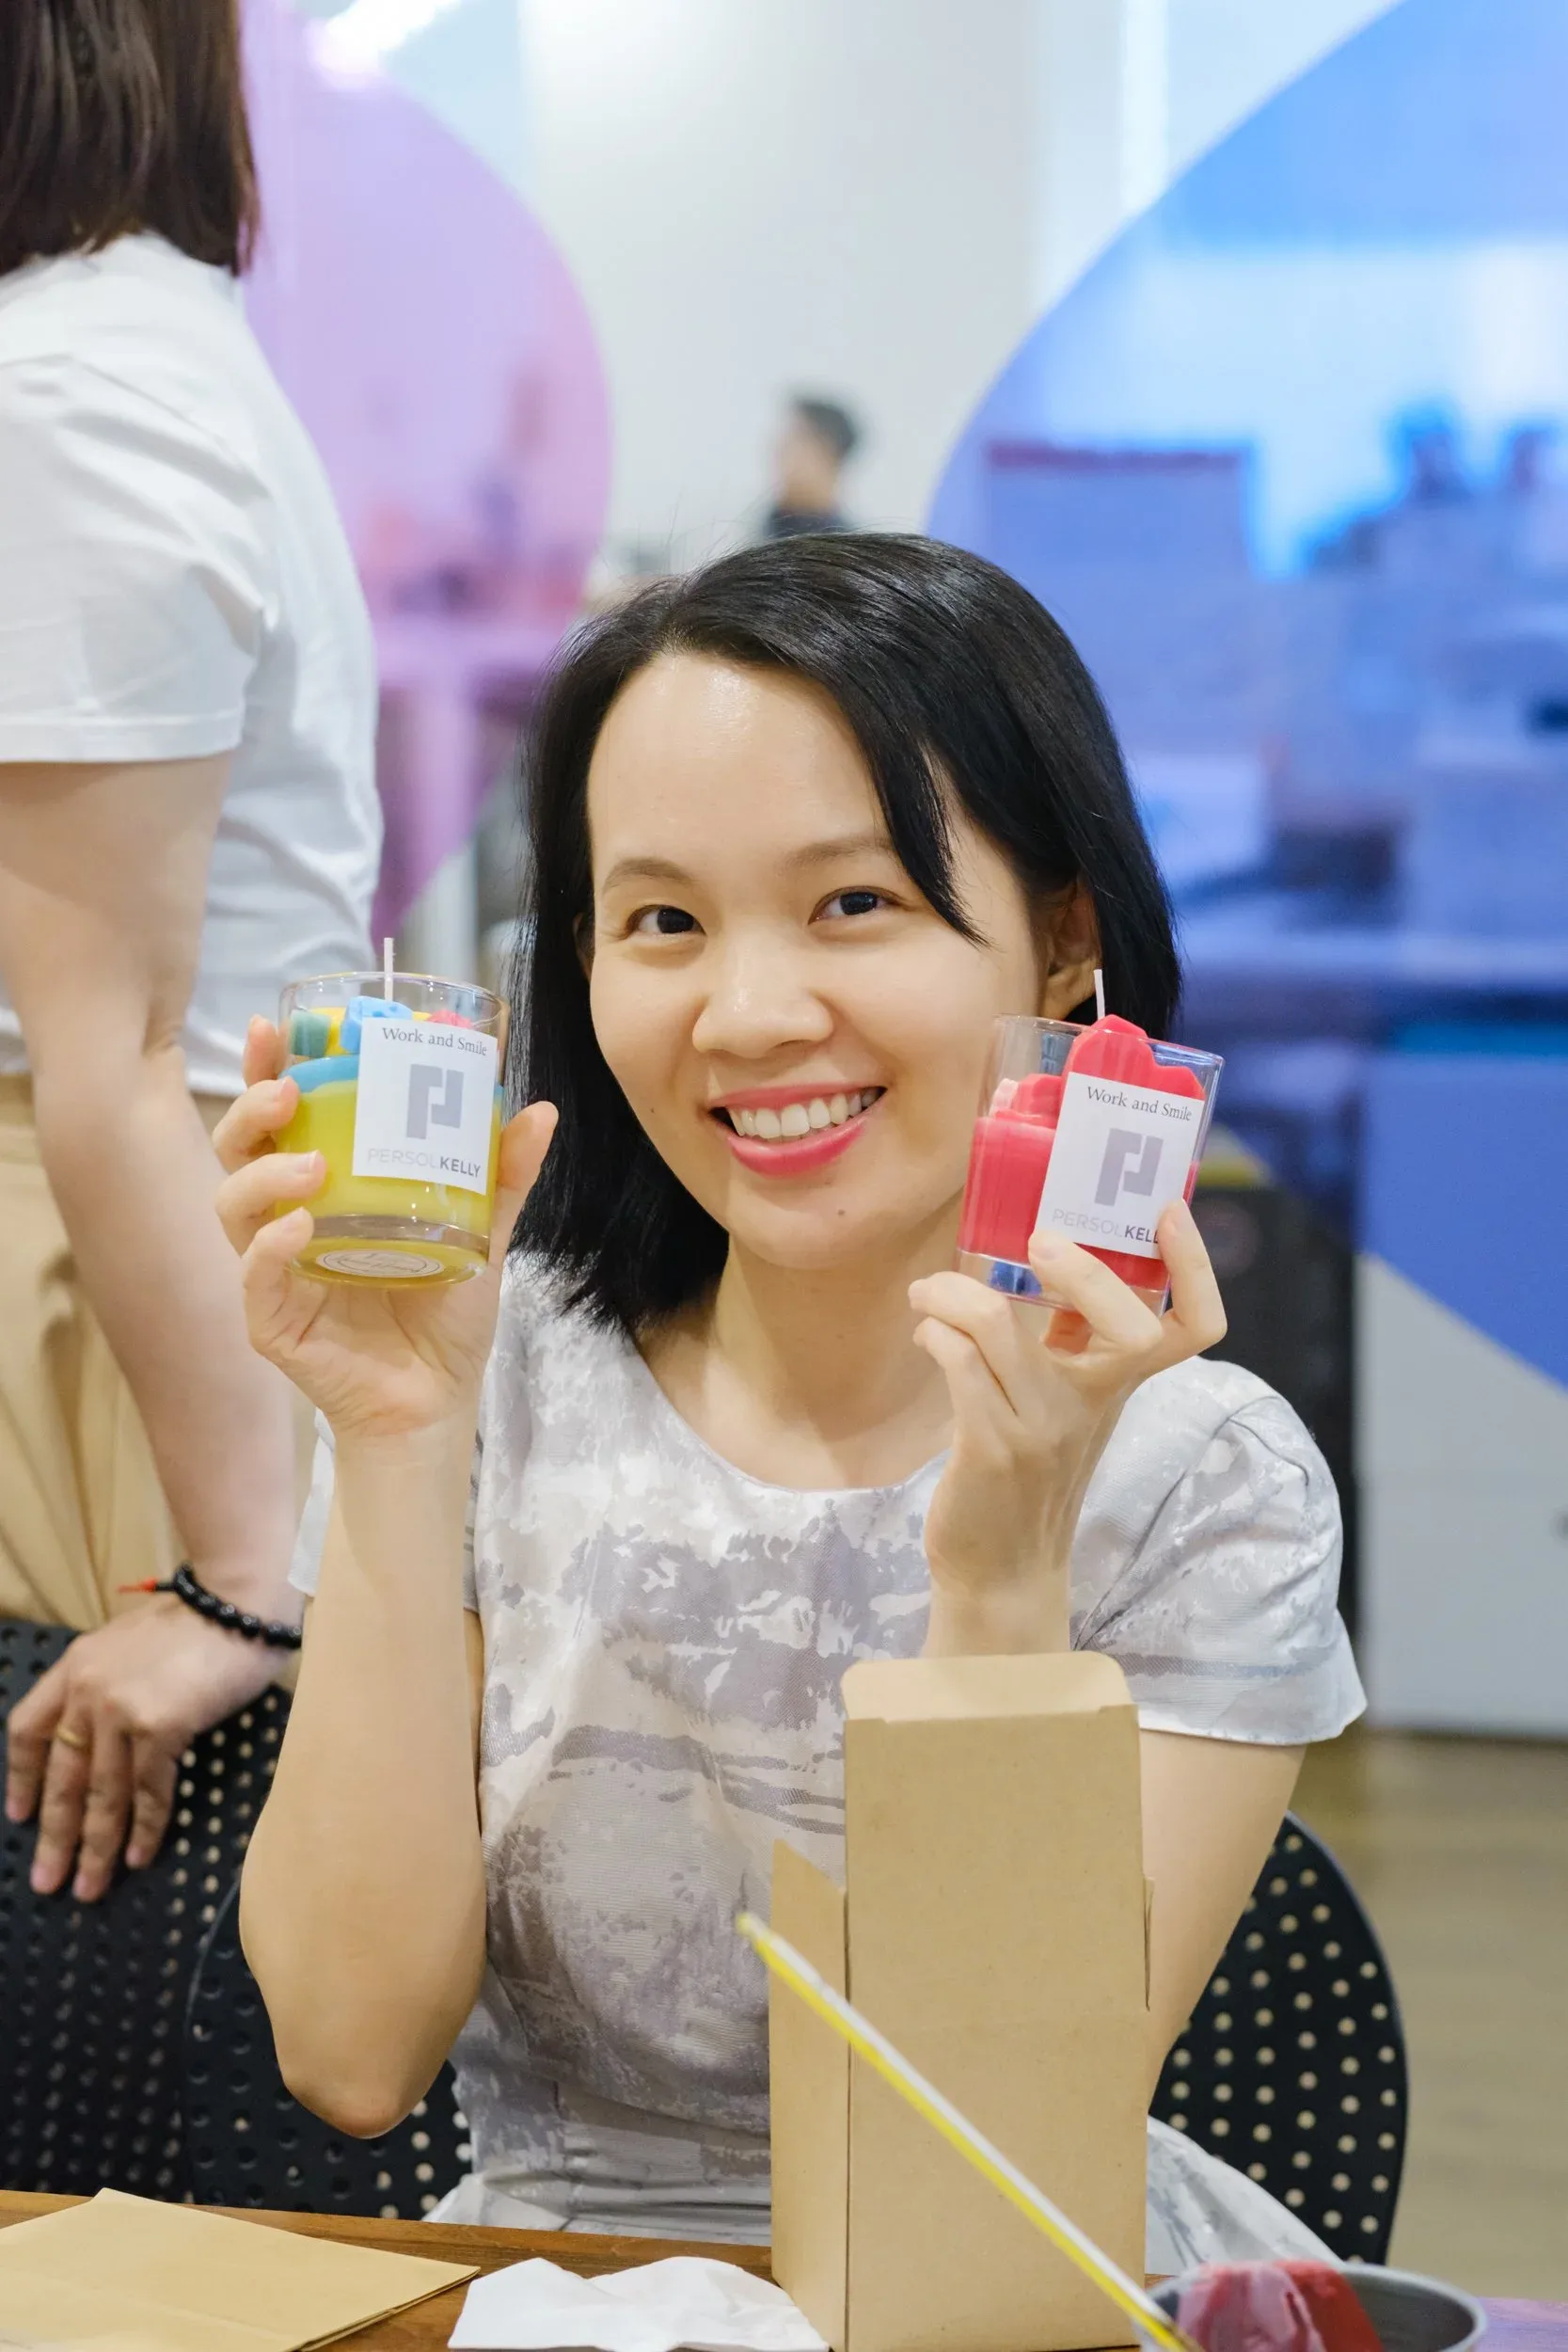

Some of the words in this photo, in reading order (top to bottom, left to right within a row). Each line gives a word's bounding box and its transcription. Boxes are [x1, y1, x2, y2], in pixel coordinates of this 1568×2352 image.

[382, 1027, 423, 1043] Work
[428, 1034, 453, 1048] and
[457, 1037, 487, 1057] Smile
[1087, 1086, 1129, 1107] Work
[1132, 1100, 1159, 1114] and
[1162, 1103, 1193, 1121] Smile
[368, 1148, 481, 1178] PERSOLKELLY
[1052, 1208, 1159, 1244] PERSOLKELL
